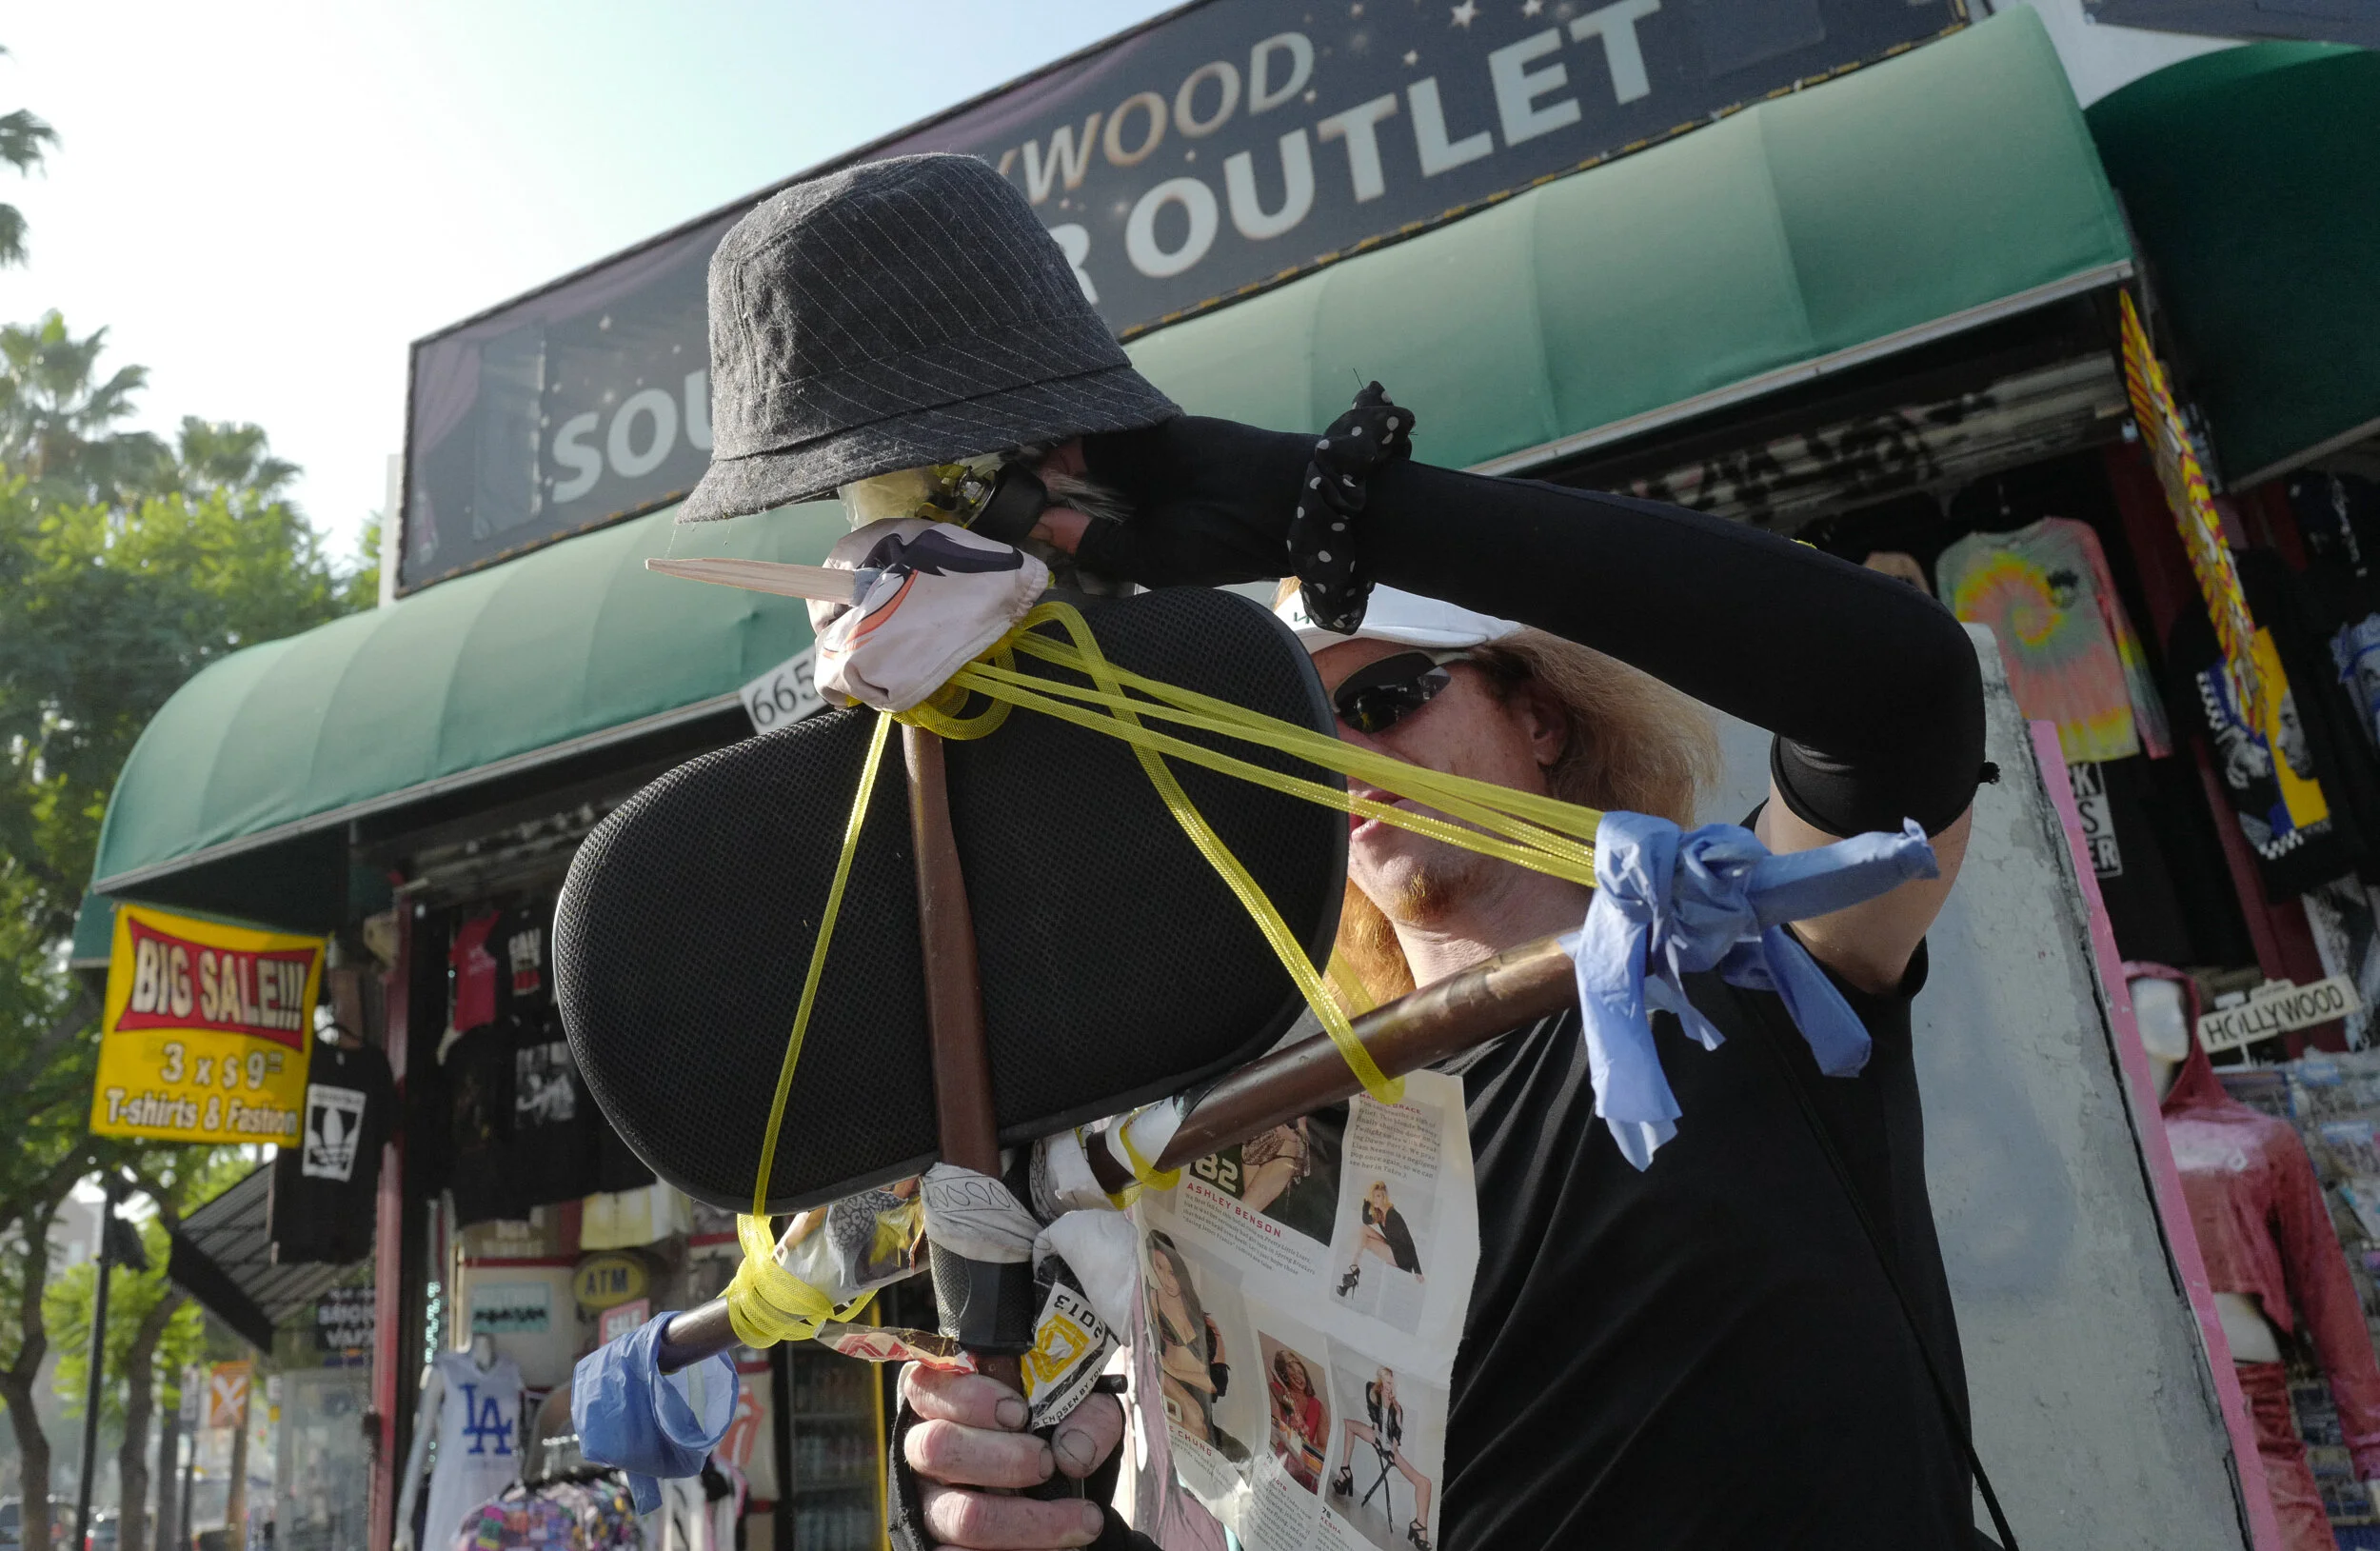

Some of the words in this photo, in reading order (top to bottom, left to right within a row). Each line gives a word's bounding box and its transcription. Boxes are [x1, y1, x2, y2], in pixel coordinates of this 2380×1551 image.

[1126, 0, 1661, 278] OUTLET
[131, 937, 193, 1019] BIG
[198, 949, 307, 1032] SALE!!!
[2204, 984, 2345, 1044] HOLLYWOOD
[160, 1043, 186, 1084] 3
[193, 1056, 214, 1086] x
[105, 1086, 198, 1130] T-shirts
[203, 1097, 221, 1131] &
[226, 1099, 298, 1136] Fashion
[1357, 1116, 1379, 1126] finally
[1393, 1104, 1422, 1115] GRACE
[1355, 1125, 1382, 1137] Twilight
[1195, 1153, 1239, 1193] 82
[1371, 1146, 1395, 1157] Neeson
[1407, 1157, 1438, 1170] negligent
[1186, 1182, 1231, 1209] ASHLEY
[1235, 1206, 1281, 1238] BENSON
[585, 1267, 628, 1295] ATM
[1053, 1294, 1104, 1339] 2013
[458, 1382, 513, 1455] LA
[1042, 1397, 1080, 1424] CHOSEN
[1079, 1382, 1091, 1396] BY
[1178, 1428, 1213, 1457] CHUNG
[1320, 1516, 1341, 1535] KESHA
[1322, 1506, 1331, 1519] 78
